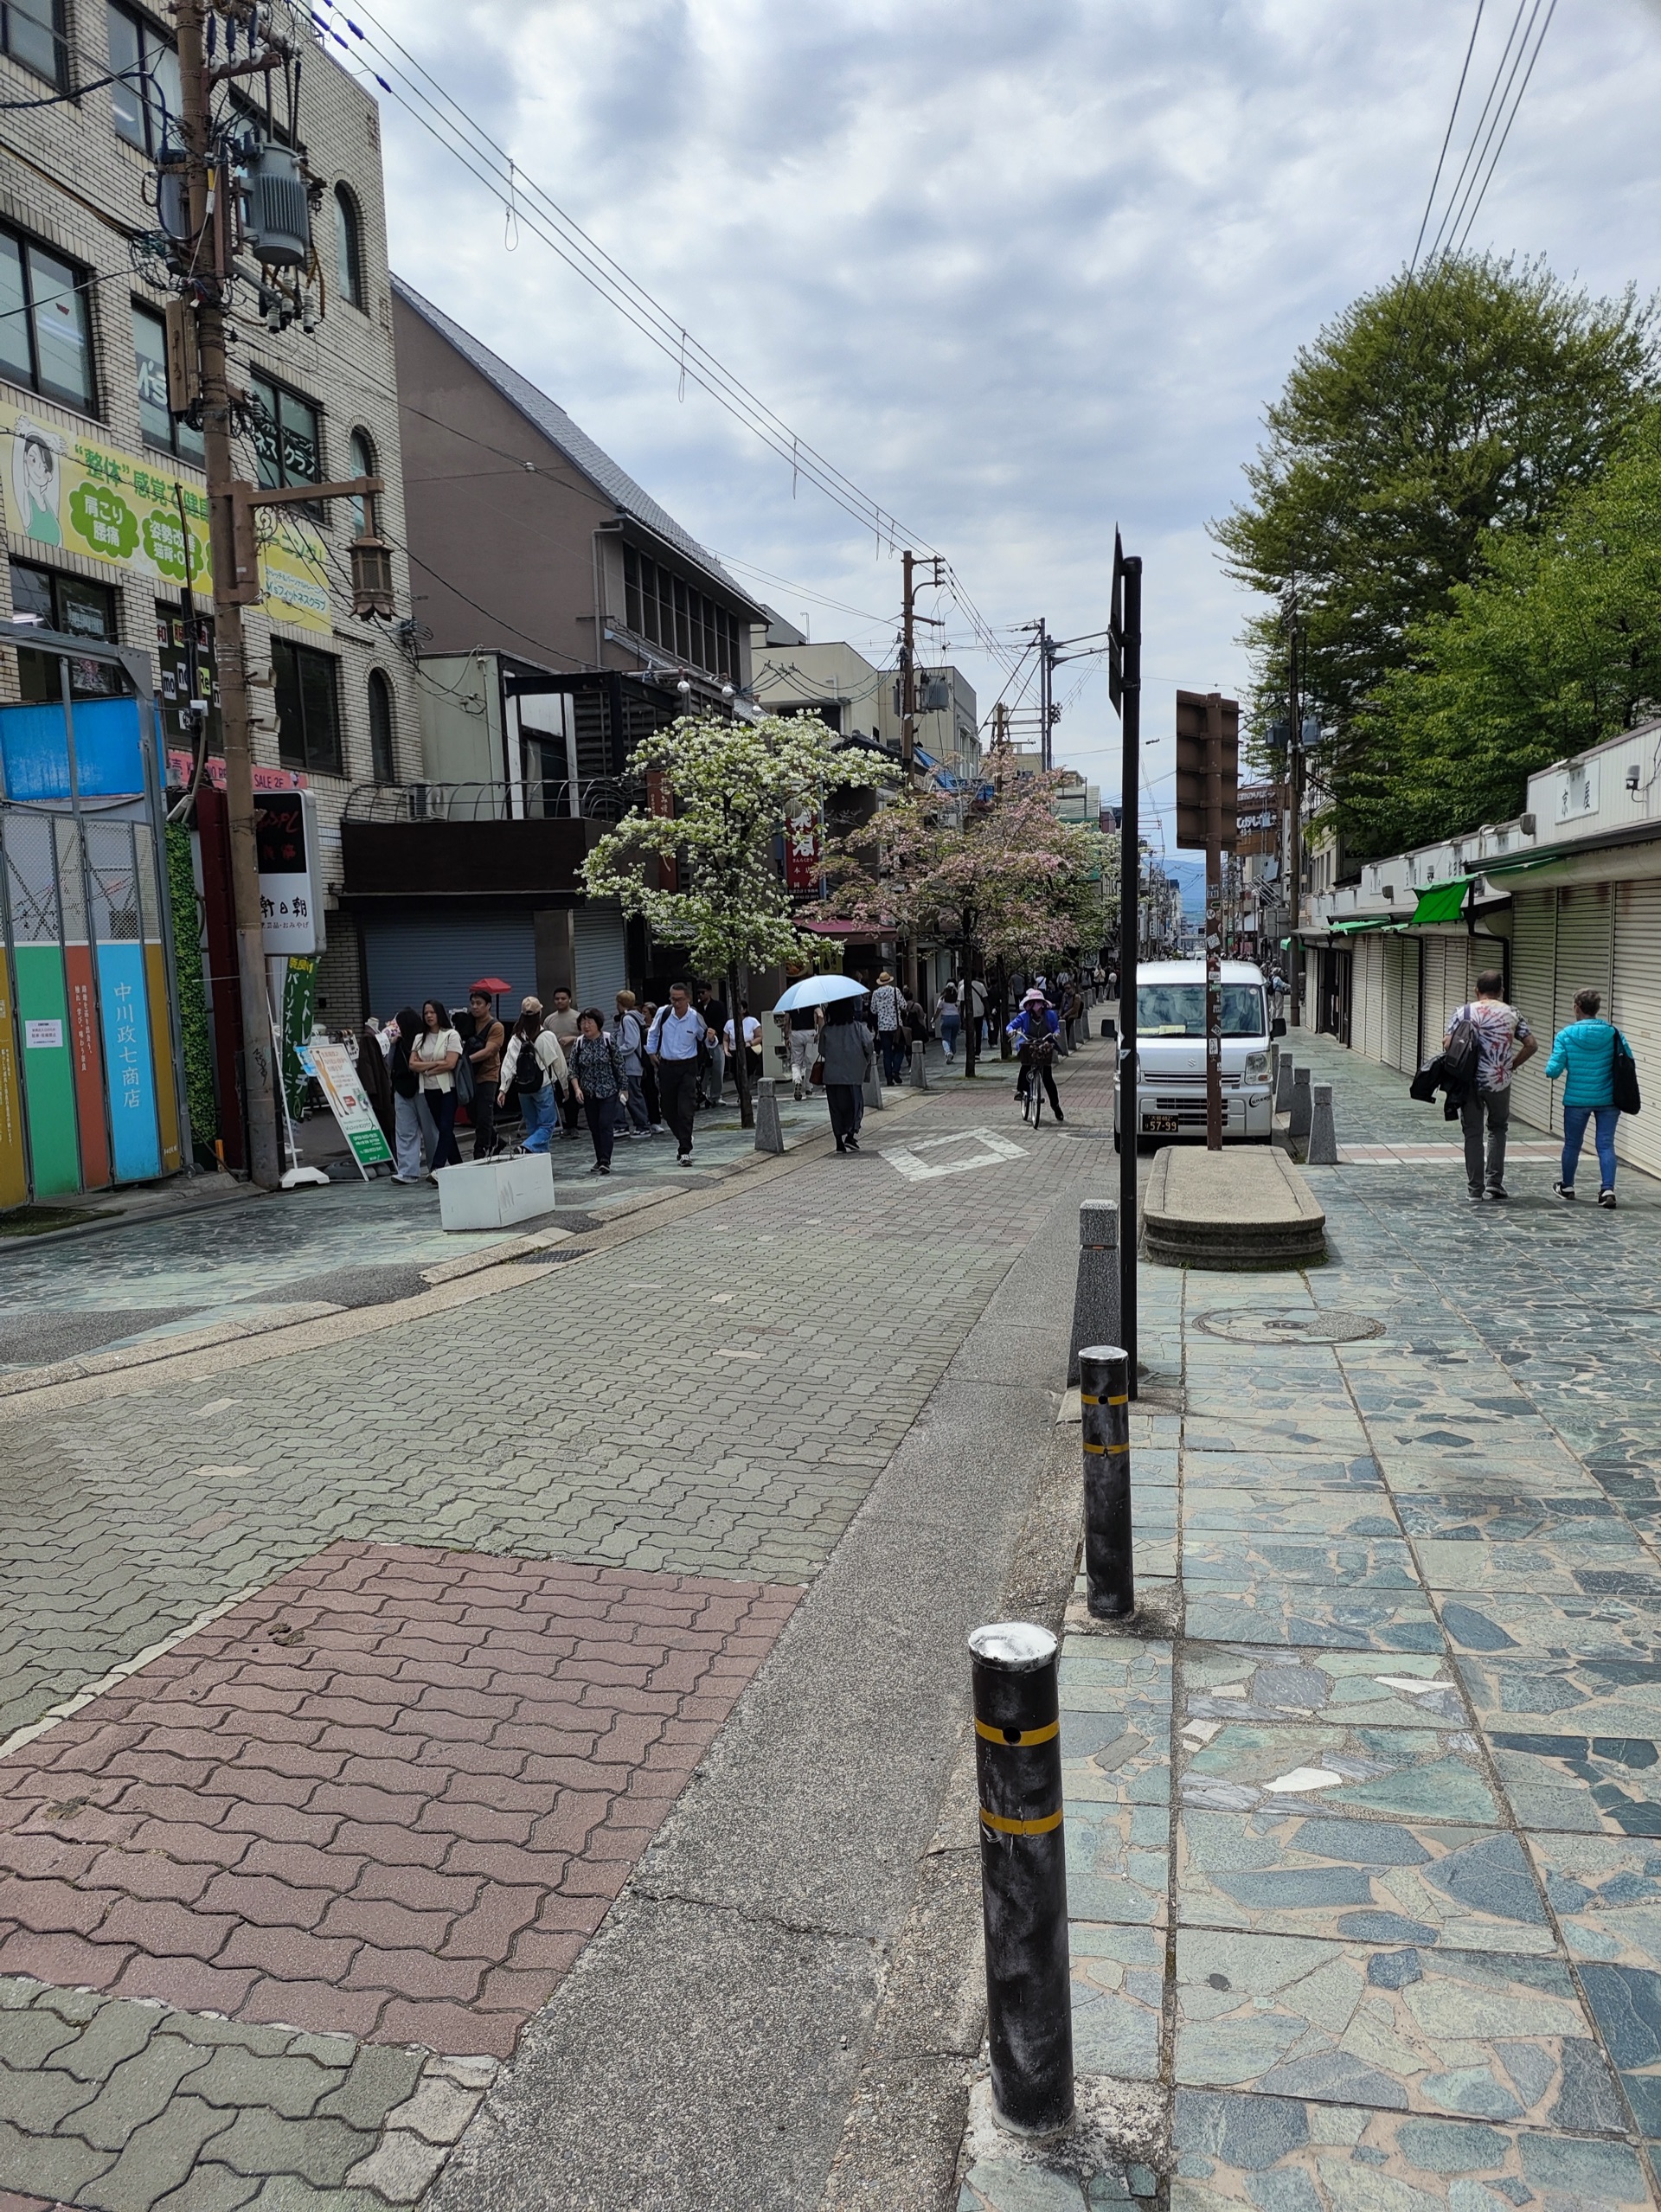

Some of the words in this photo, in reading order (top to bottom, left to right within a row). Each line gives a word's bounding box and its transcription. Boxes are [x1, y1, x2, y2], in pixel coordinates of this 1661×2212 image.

[84, 494, 123, 524] 肩こり
[93, 521, 119, 548] 腰痛
[253, 774, 273, 789] SALE
[274, 777, 284, 789] 2F
[113, 982, 141, 1108] 中川政七商店
[1150, 1120, 1177, 1132] 57-99
